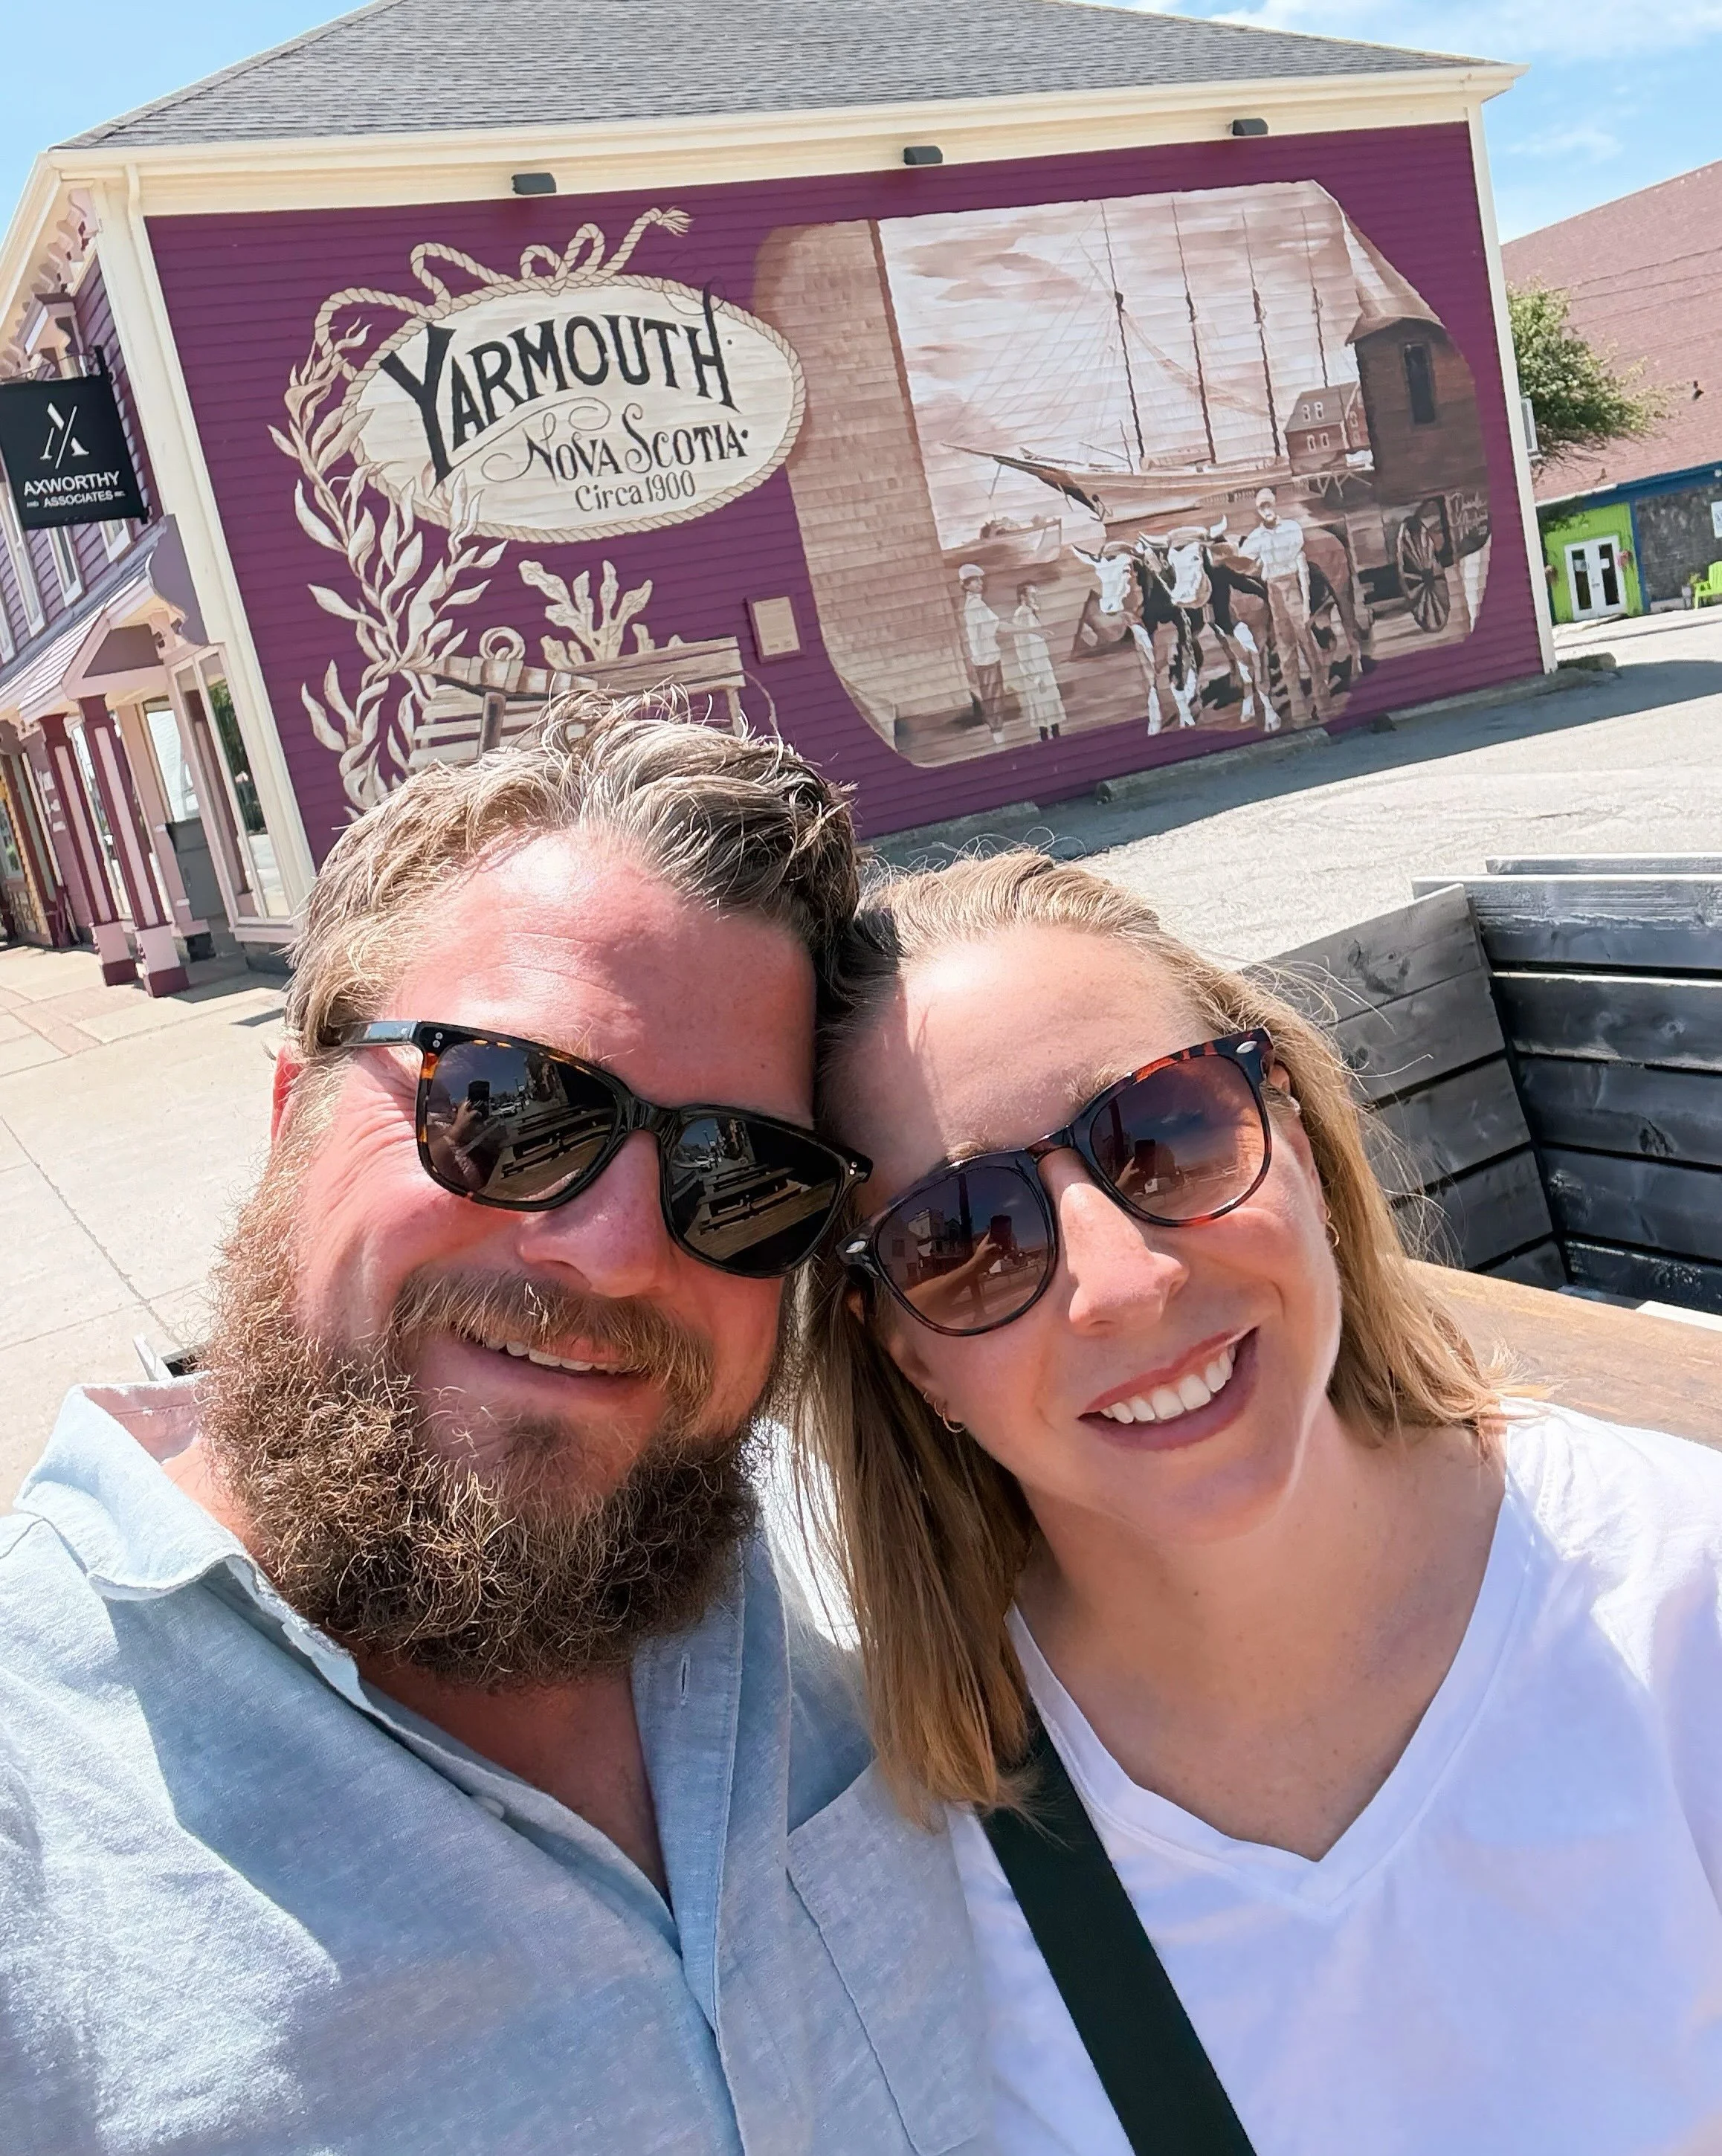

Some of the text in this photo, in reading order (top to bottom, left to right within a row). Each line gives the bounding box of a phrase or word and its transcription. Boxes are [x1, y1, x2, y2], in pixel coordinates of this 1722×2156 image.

[380, 279, 742, 497] YARMOUTH
[24, 471, 120, 497] AXWORTHY
[43, 491, 114, 508] ASSOCIATES
[575, 470, 696, 511] Circa 1900
